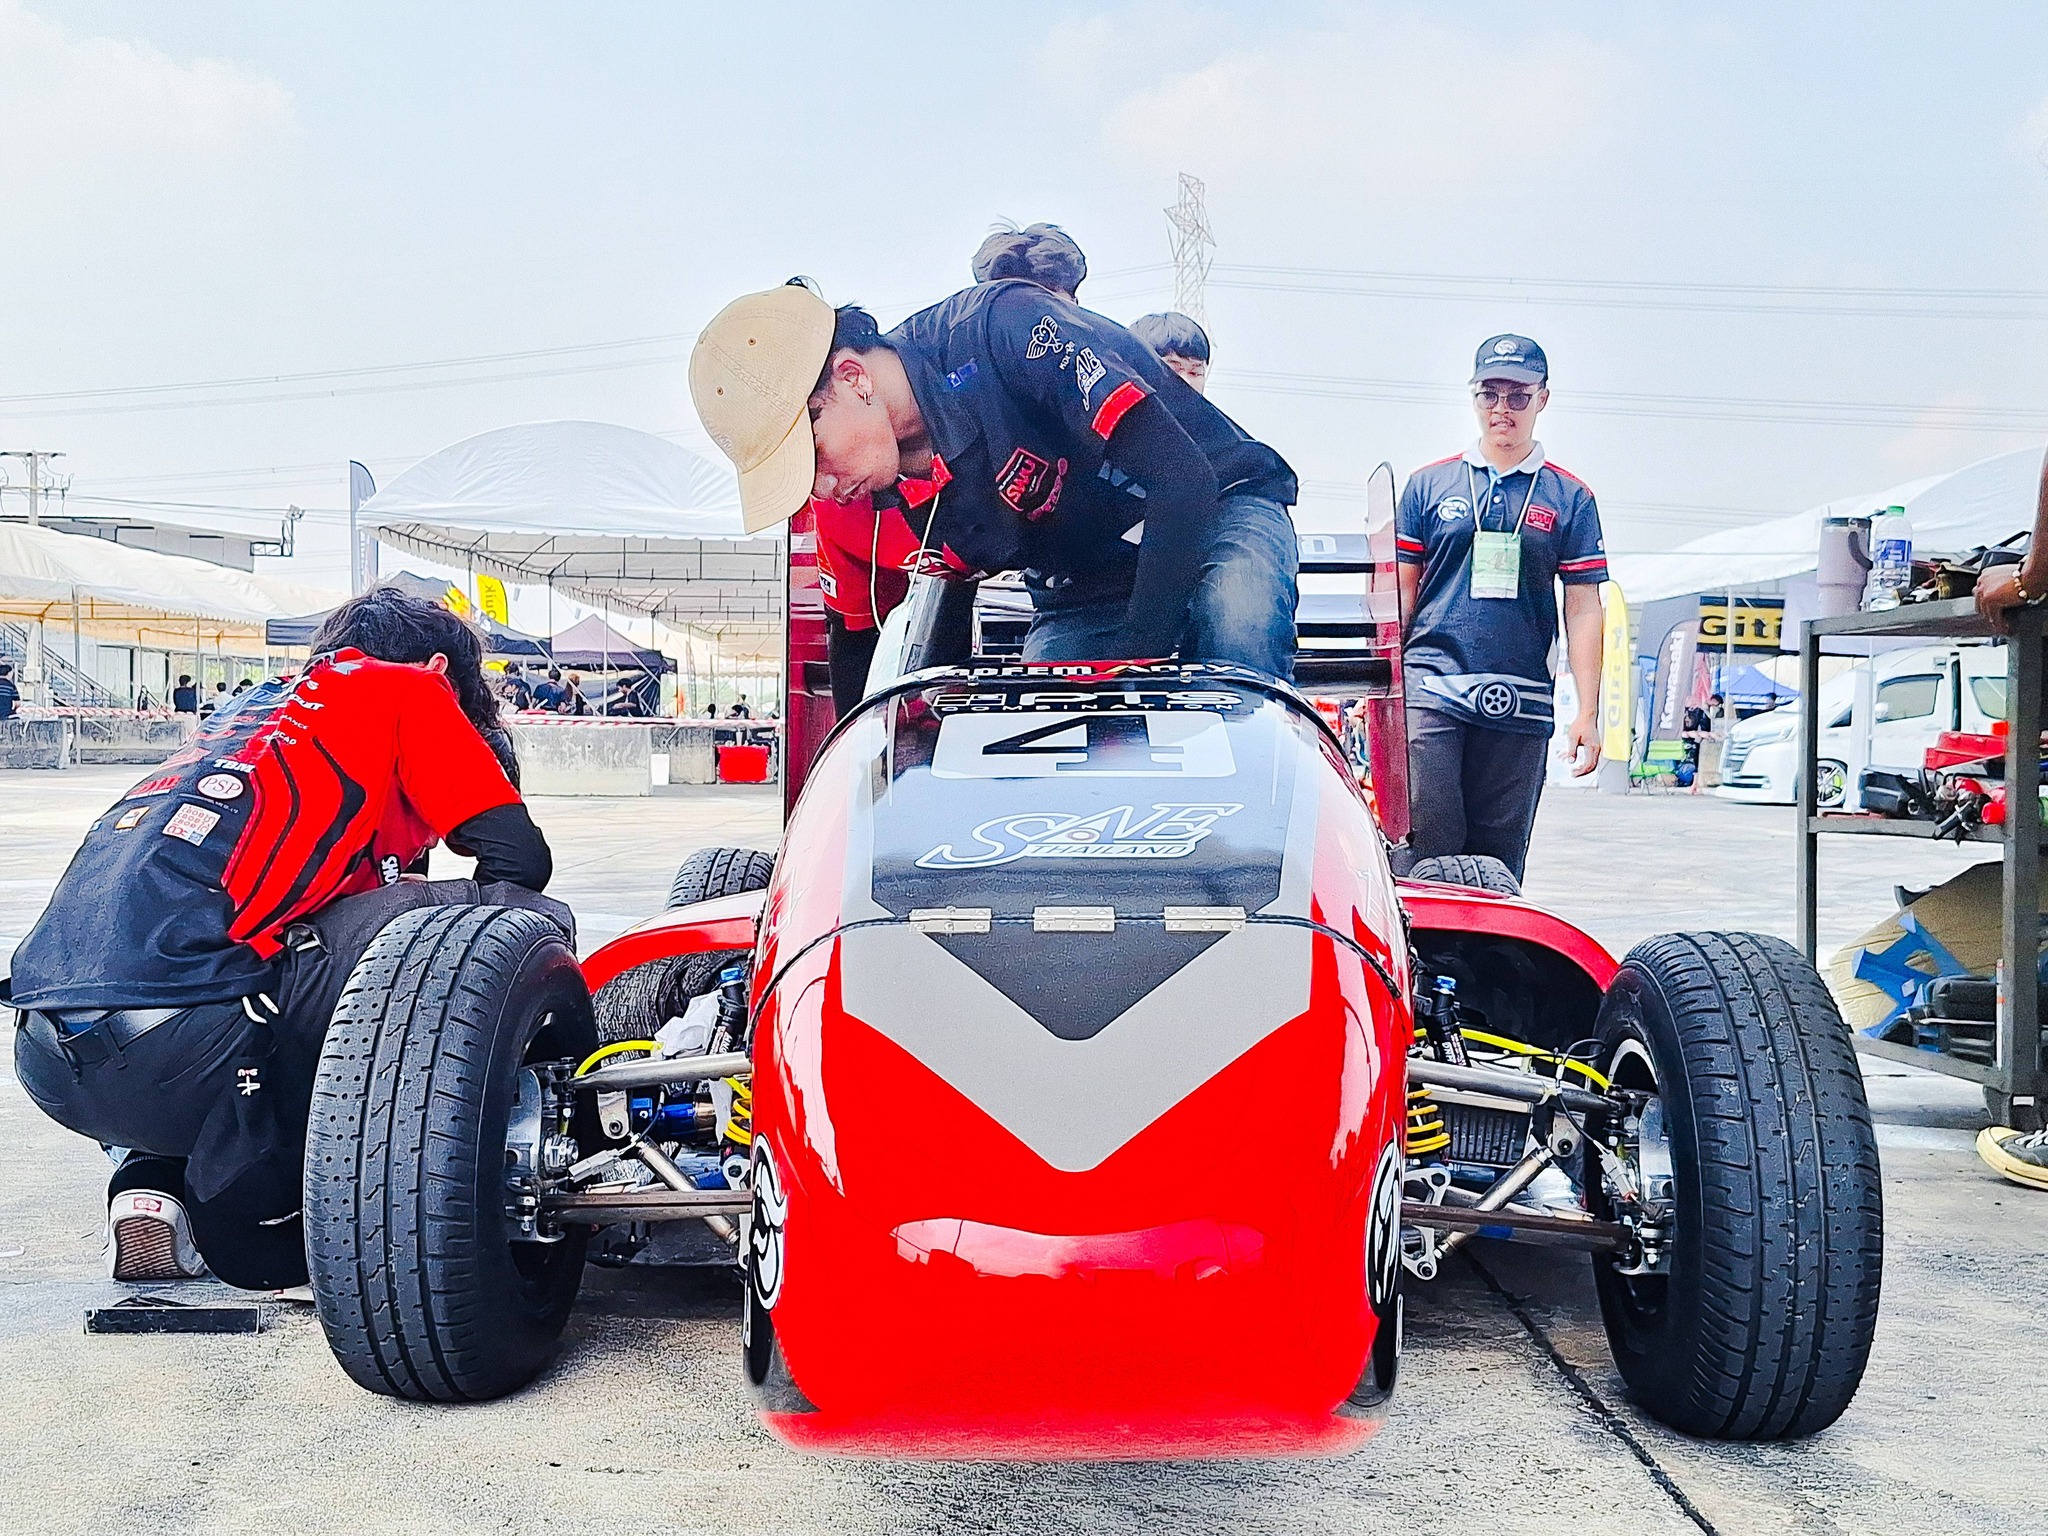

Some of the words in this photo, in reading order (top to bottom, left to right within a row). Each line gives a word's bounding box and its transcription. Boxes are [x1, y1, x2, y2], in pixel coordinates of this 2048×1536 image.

[1660, 630, 1686, 729] Kawasaki
[1019, 691, 1243, 706] PTS
[981, 714, 1185, 771] 4
[201, 777, 242, 795] PSP
[1030, 844, 1188, 855] THAILAND
